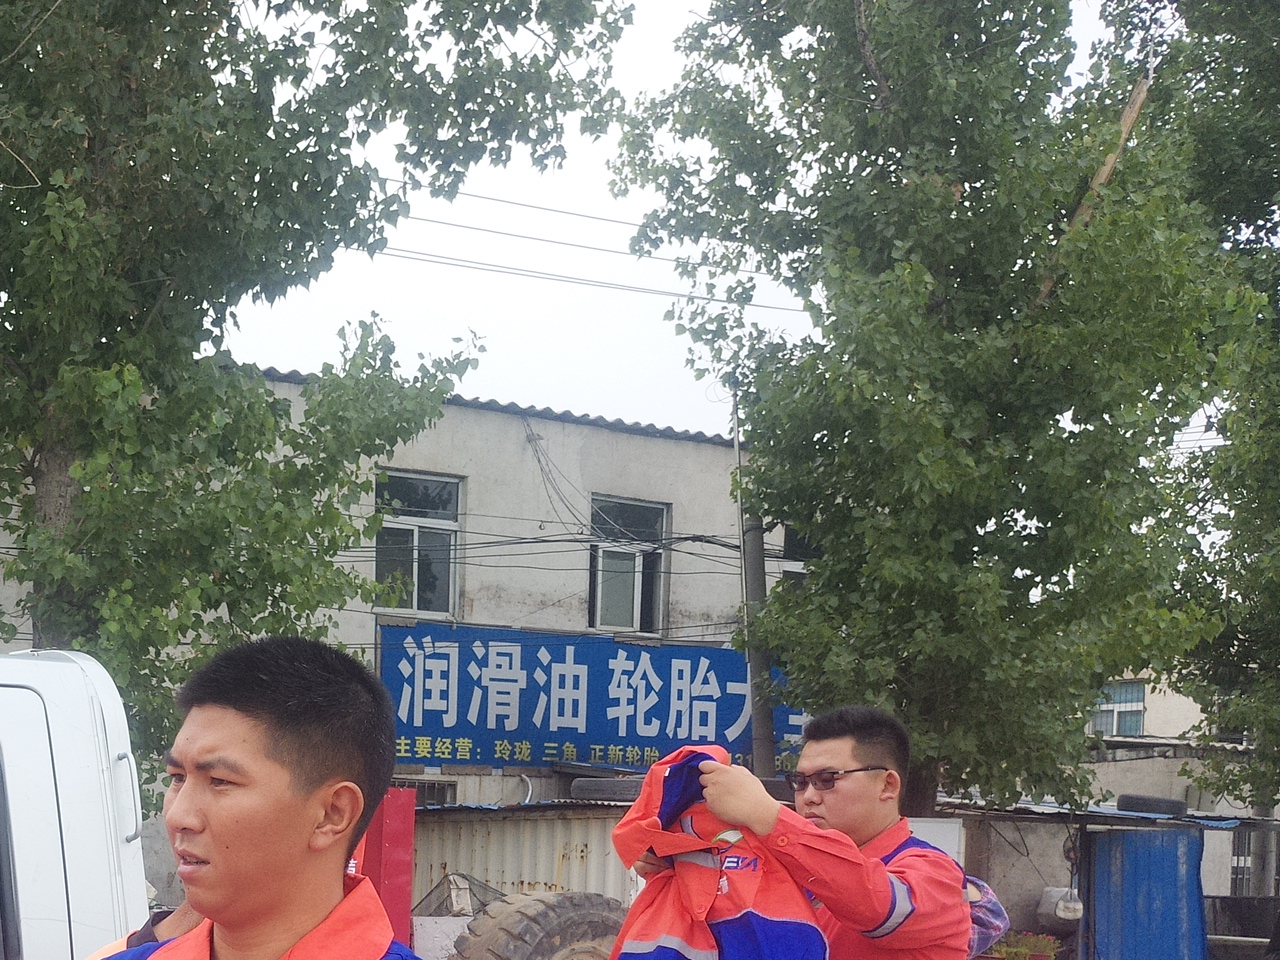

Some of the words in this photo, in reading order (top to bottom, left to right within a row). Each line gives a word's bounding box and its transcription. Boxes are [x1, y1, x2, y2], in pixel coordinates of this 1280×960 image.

[397, 635, 588, 733] 润滑油
[495, 739, 531, 762] 玲珑
[542, 741, 578, 763] 三角
[588, 744, 661, 768] 正新轮胎
